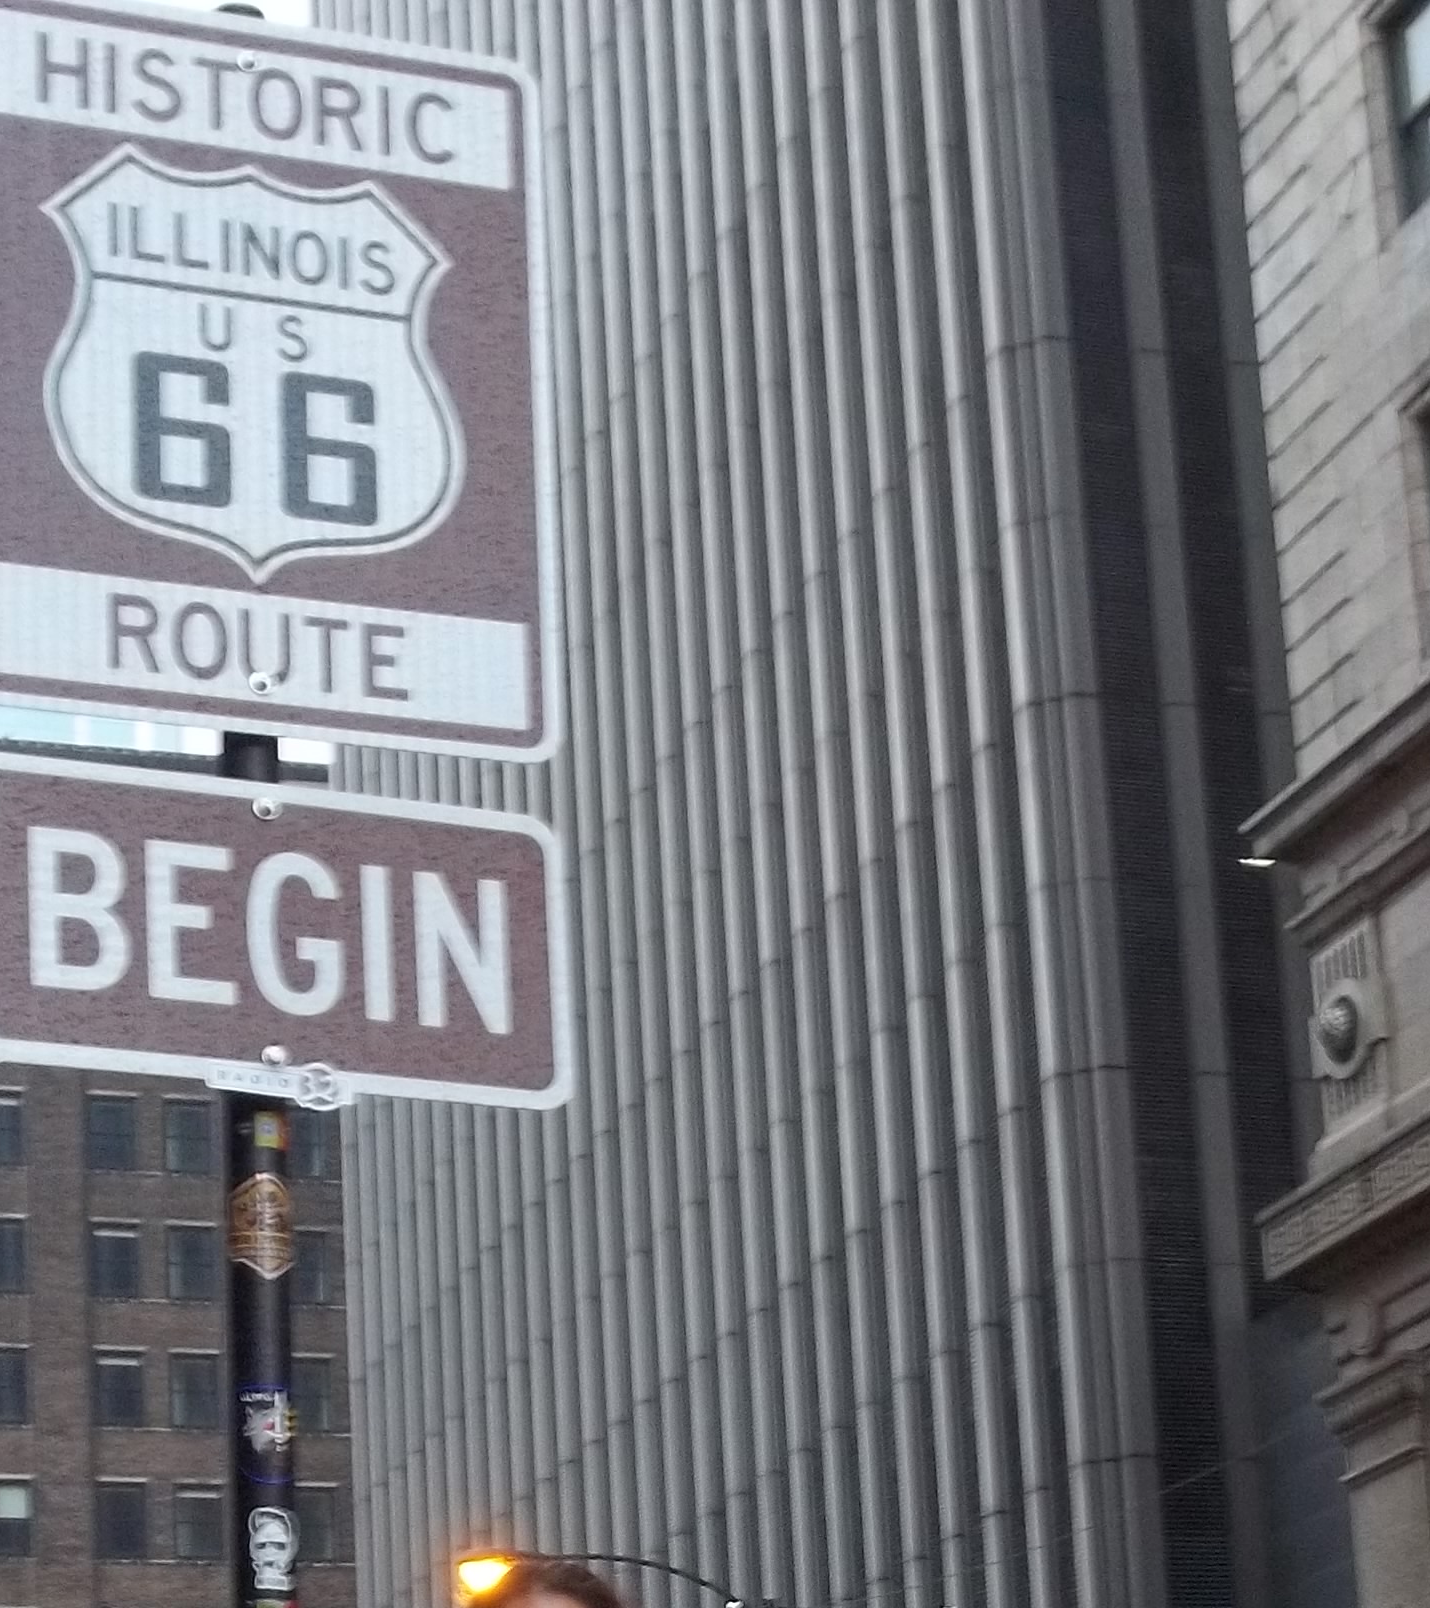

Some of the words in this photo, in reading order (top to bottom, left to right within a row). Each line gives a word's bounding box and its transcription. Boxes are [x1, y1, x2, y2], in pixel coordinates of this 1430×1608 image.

[36, 31, 455, 164] HISTORIC
[107, 201, 396, 296] ILLINOIS
[199, 302, 232, 352] U
[277, 314, 309, 362] S
[130, 351, 378, 527] 66
[105, 592, 410, 702] ROUTE
[28, 826, 515, 1035] BEGIN
